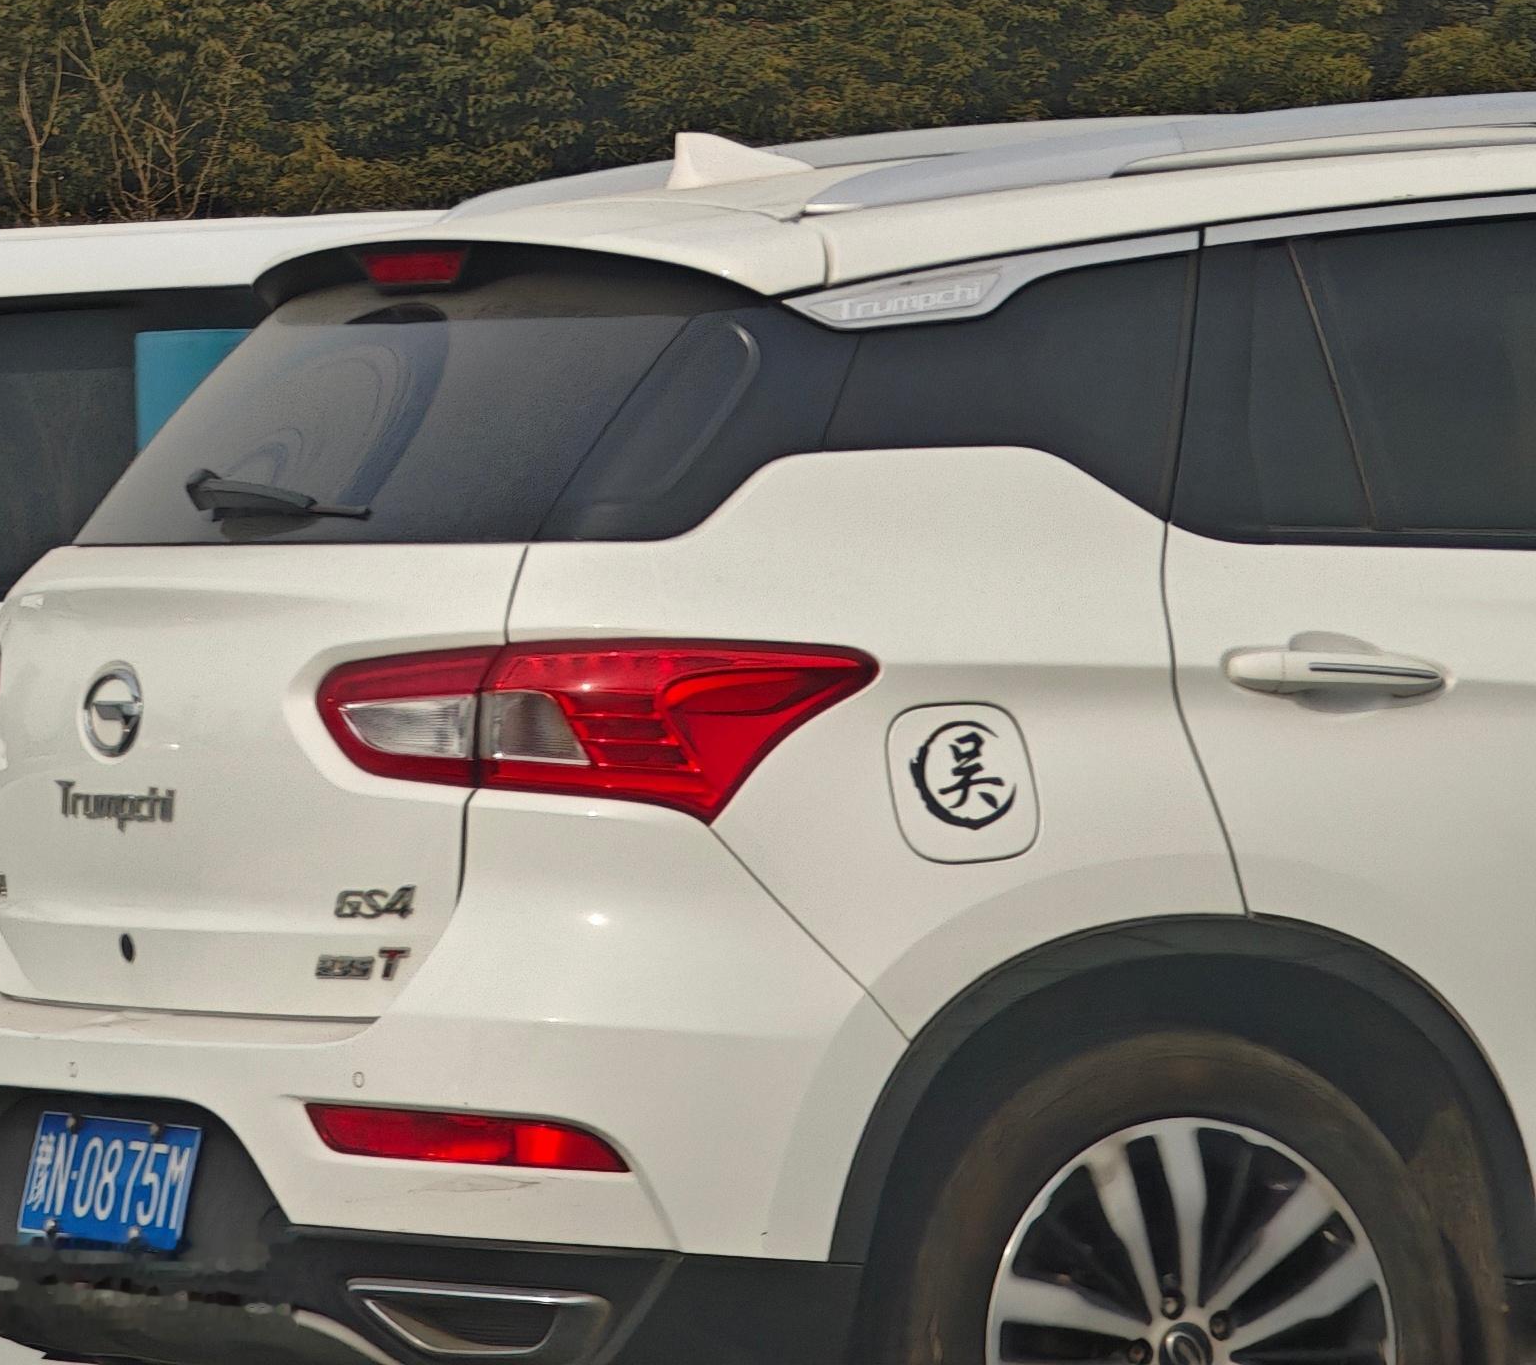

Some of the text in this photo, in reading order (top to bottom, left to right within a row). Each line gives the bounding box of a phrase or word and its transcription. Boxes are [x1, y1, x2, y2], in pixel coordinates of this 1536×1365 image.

[838, 282, 982, 319] Trumpchi
[938, 731, 1005, 809] 吴
[54, 779, 176, 832] Trumpchi
[334, 884, 417, 919] GS4
